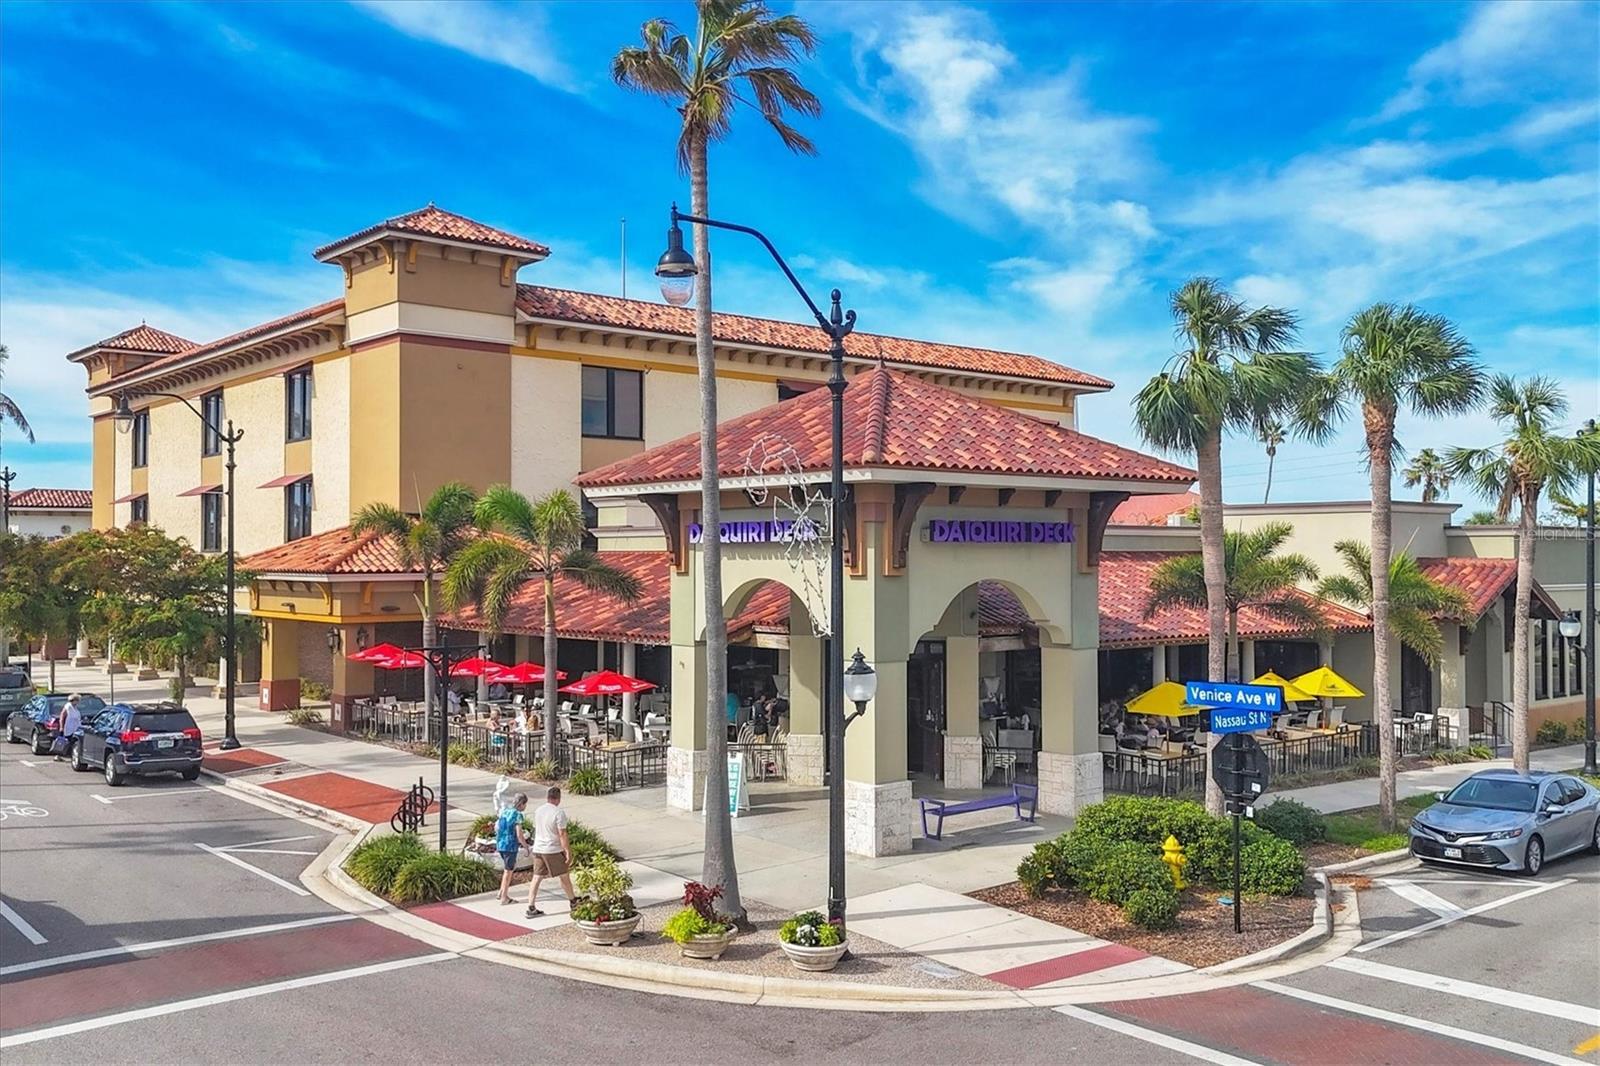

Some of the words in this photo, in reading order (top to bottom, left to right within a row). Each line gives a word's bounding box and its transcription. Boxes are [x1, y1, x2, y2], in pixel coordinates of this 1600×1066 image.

[688, 520, 765, 544] DQUIRI
[933, 519, 1026, 543] DAIQUIRI
[1031, 521, 1076, 543] DECK
[1191, 687, 1232, 703] Venice
[1236, 690, 1261, 705] Ave
[1265, 692, 1276, 706] W
[1215, 714, 1246, 728] Nassau
[1248, 712, 1258, 725] St
[1260, 712, 1266, 724] N
